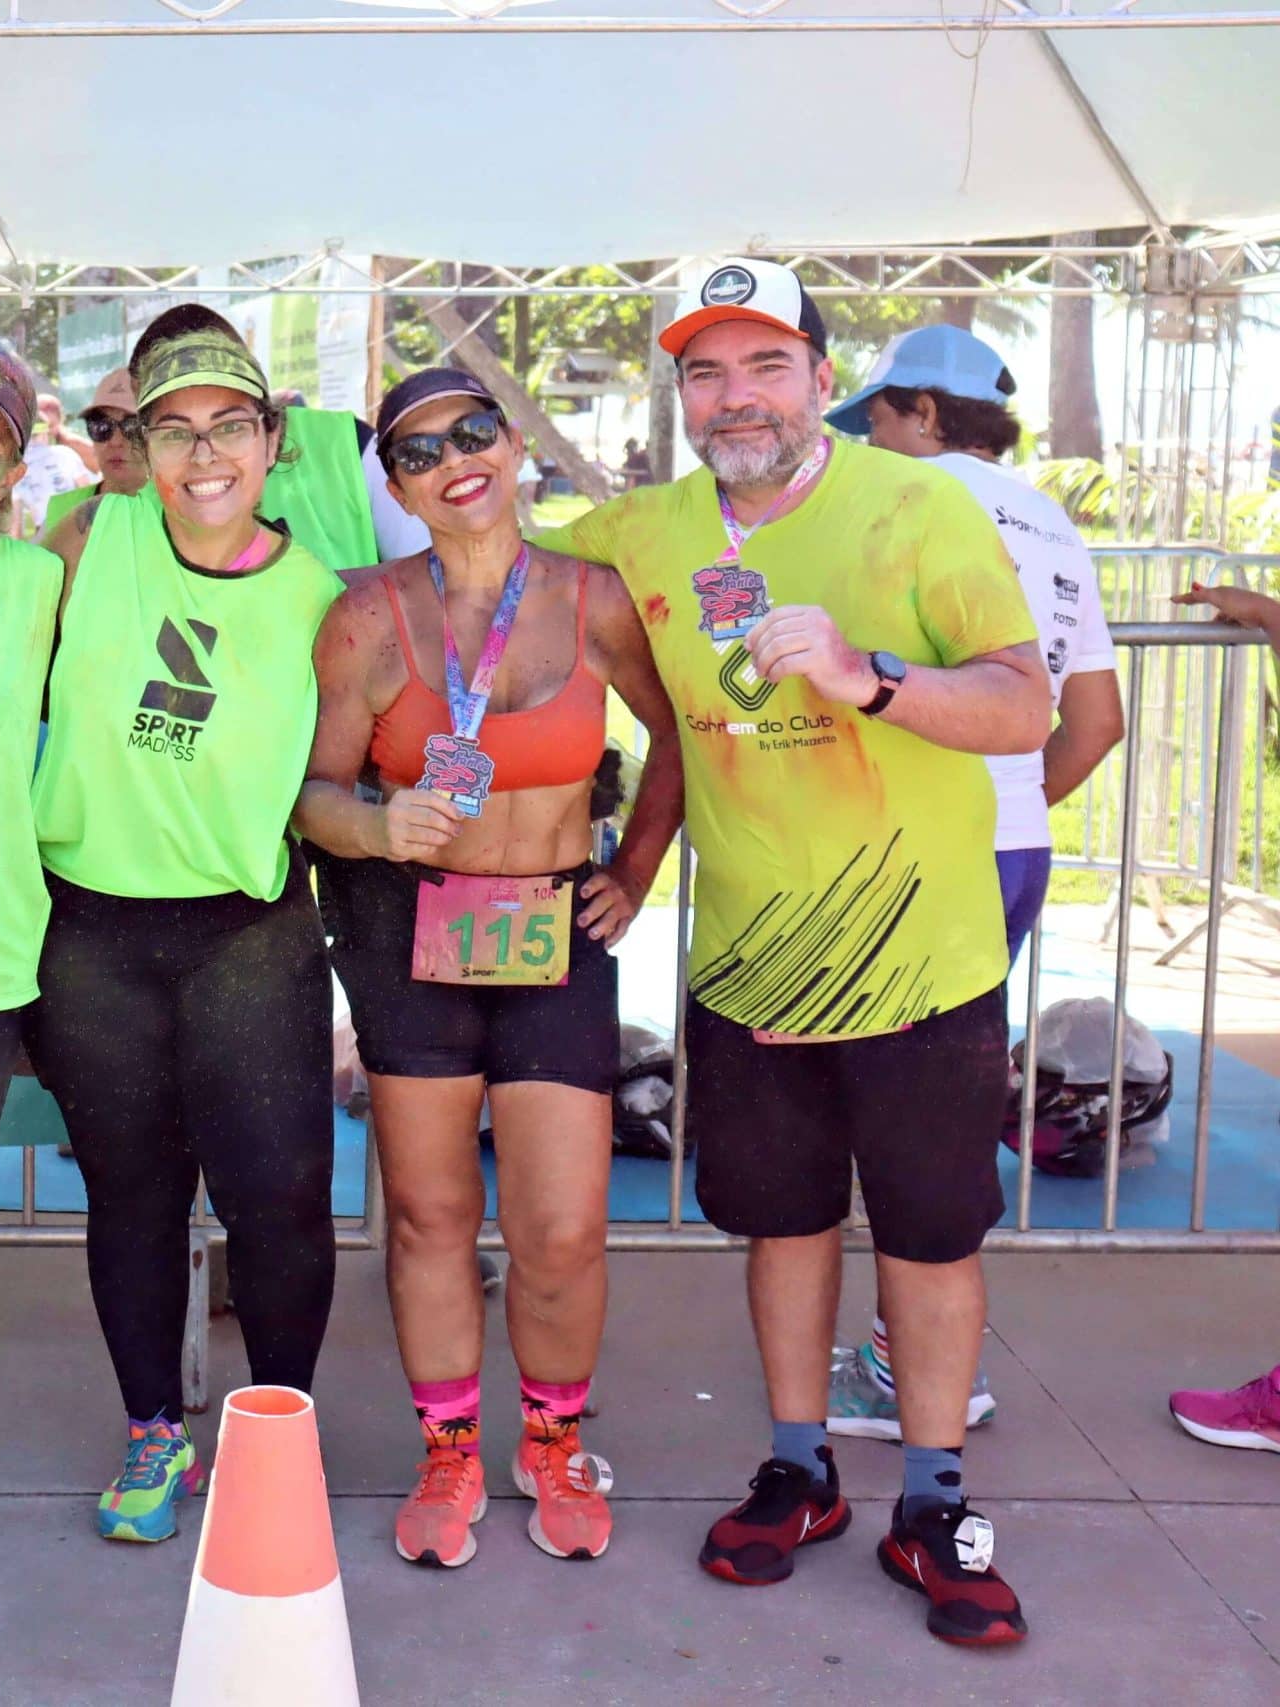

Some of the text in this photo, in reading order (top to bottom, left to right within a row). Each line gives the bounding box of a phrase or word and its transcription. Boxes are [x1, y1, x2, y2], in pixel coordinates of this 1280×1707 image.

[789, 714, 834, 732] Club
[127, 731, 196, 763] MADSS
[759, 739, 772, 753] By
[773, 738, 791, 750] Erik
[447, 911, 556, 966] 115
